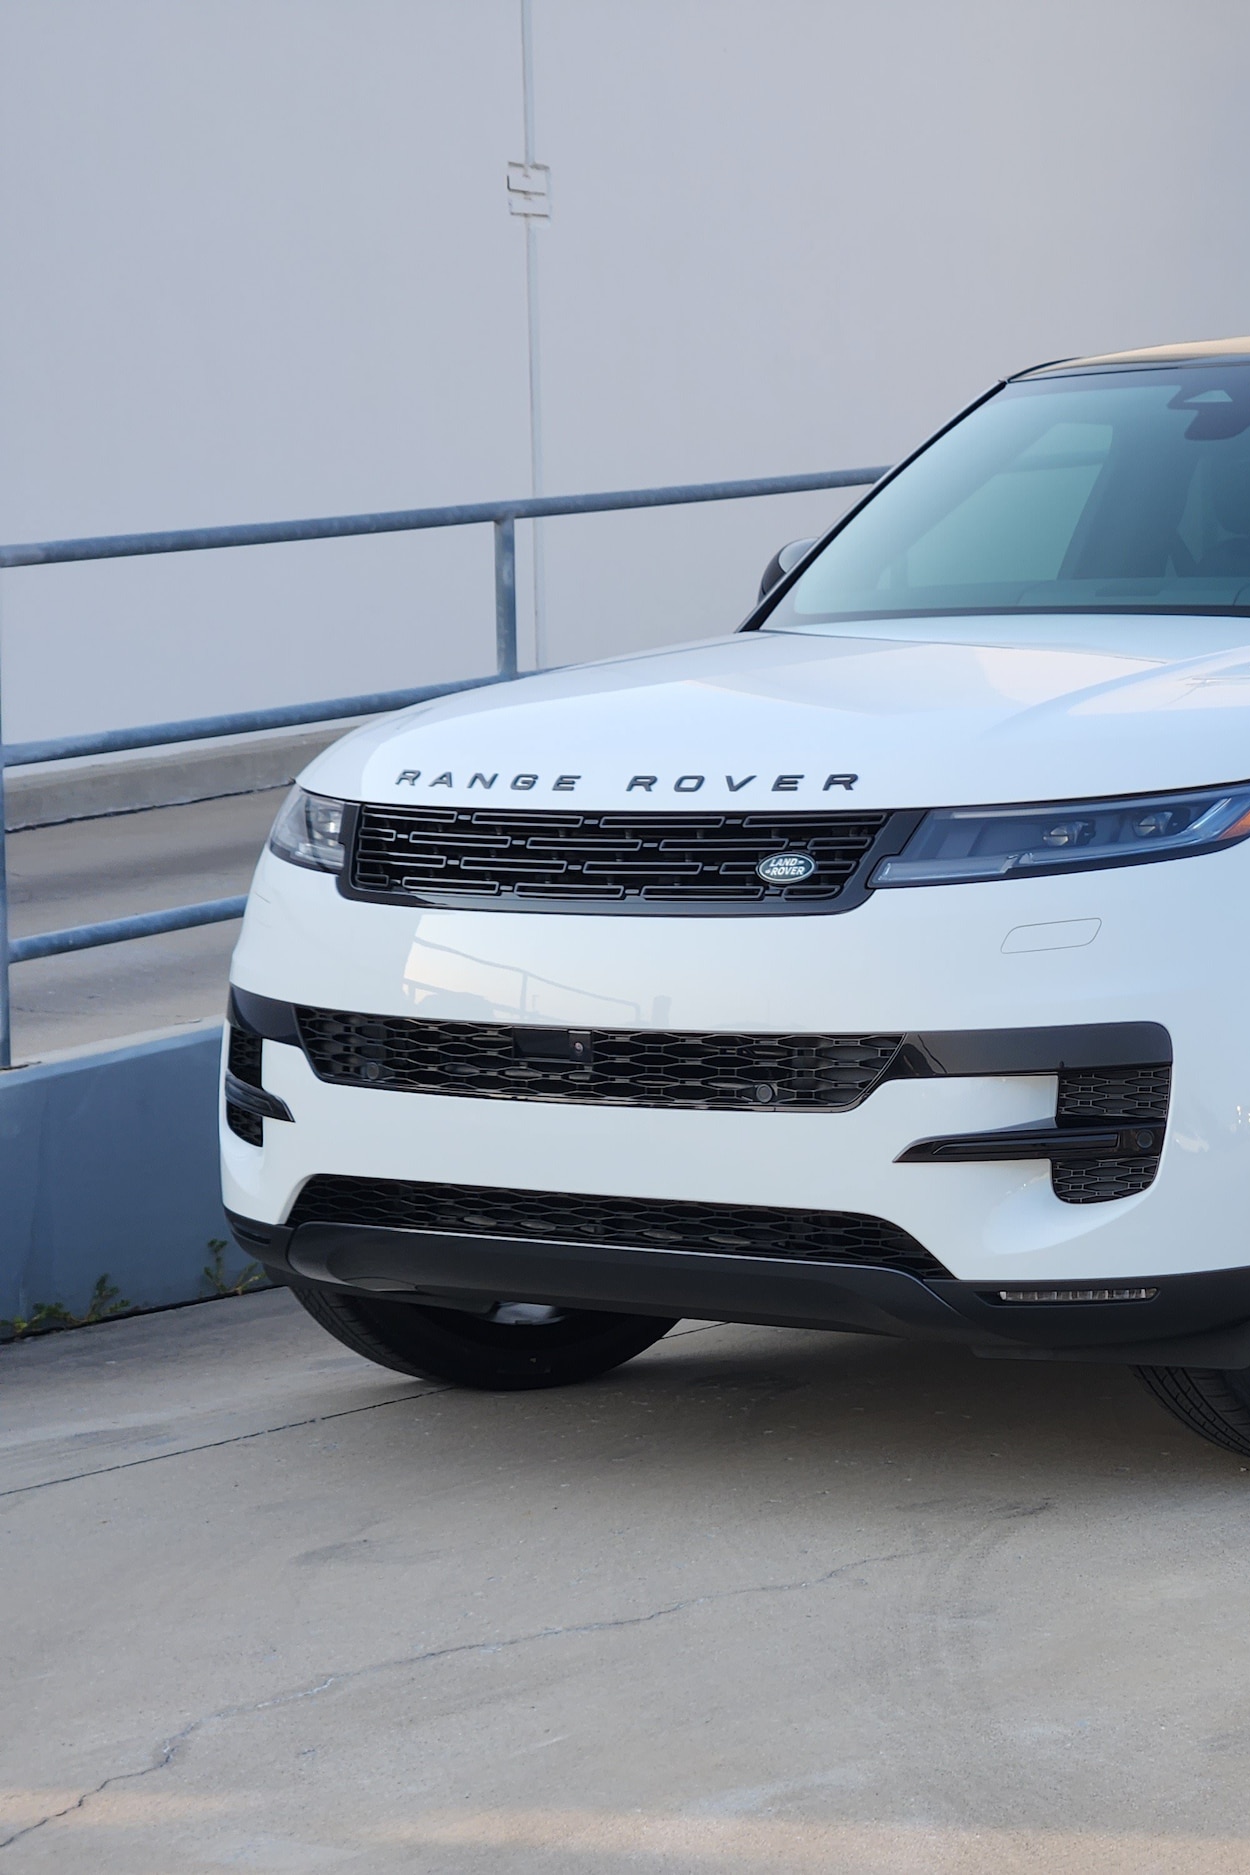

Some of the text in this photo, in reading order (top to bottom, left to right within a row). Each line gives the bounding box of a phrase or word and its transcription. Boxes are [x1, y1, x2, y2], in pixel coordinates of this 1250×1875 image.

[394, 768, 860, 793] RANGE ROVER
[769, 857, 806, 876] LAND ROVER
